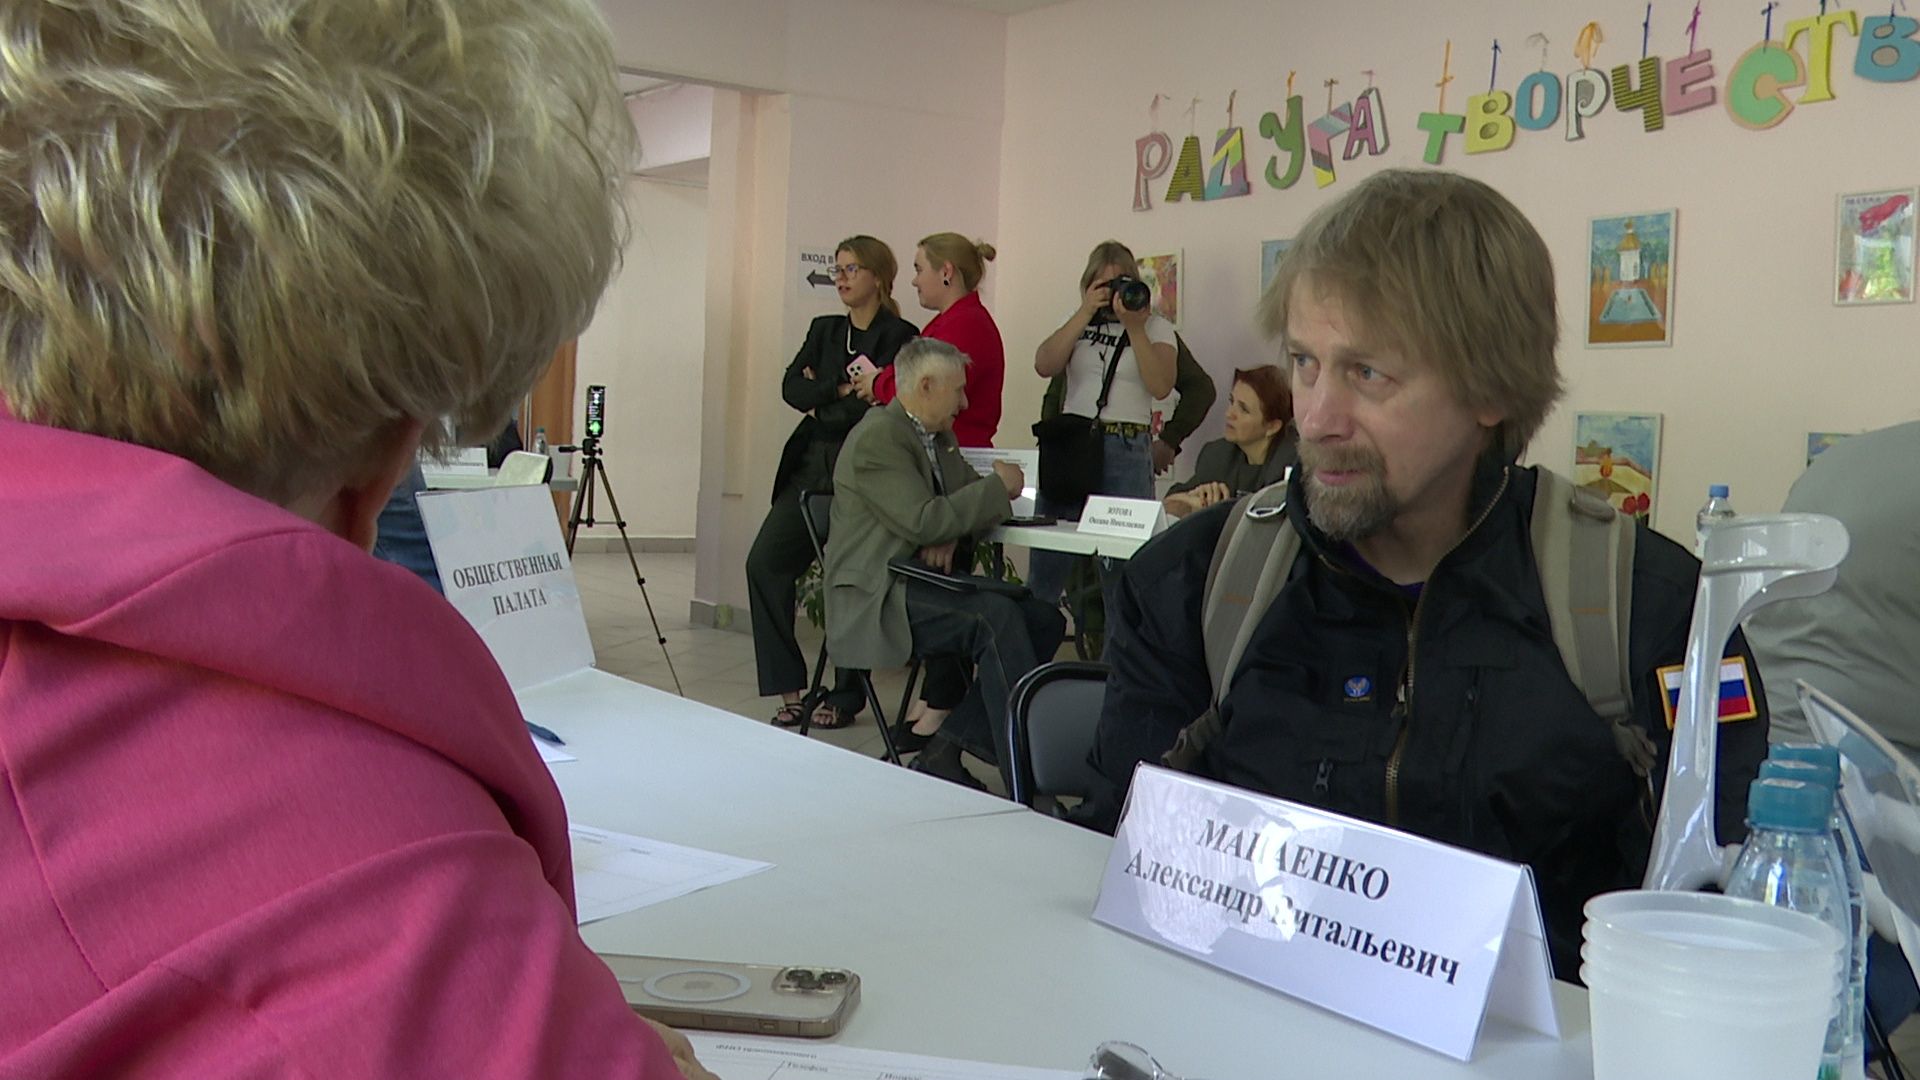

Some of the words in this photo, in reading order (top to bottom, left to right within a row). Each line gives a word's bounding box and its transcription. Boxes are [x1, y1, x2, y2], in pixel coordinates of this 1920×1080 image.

[1132, 87, 1390, 211] РАДУГА
[1418, 9, 1920, 164] ТВОРЧЕСТВ
[801, 252, 826, 265] ВХОД
[453, 552, 563, 589] ОБЩЕСТВЕННАЯ
[493, 588, 547, 615] ПАЛАТА
[1124, 848, 1263, 924] Александр
